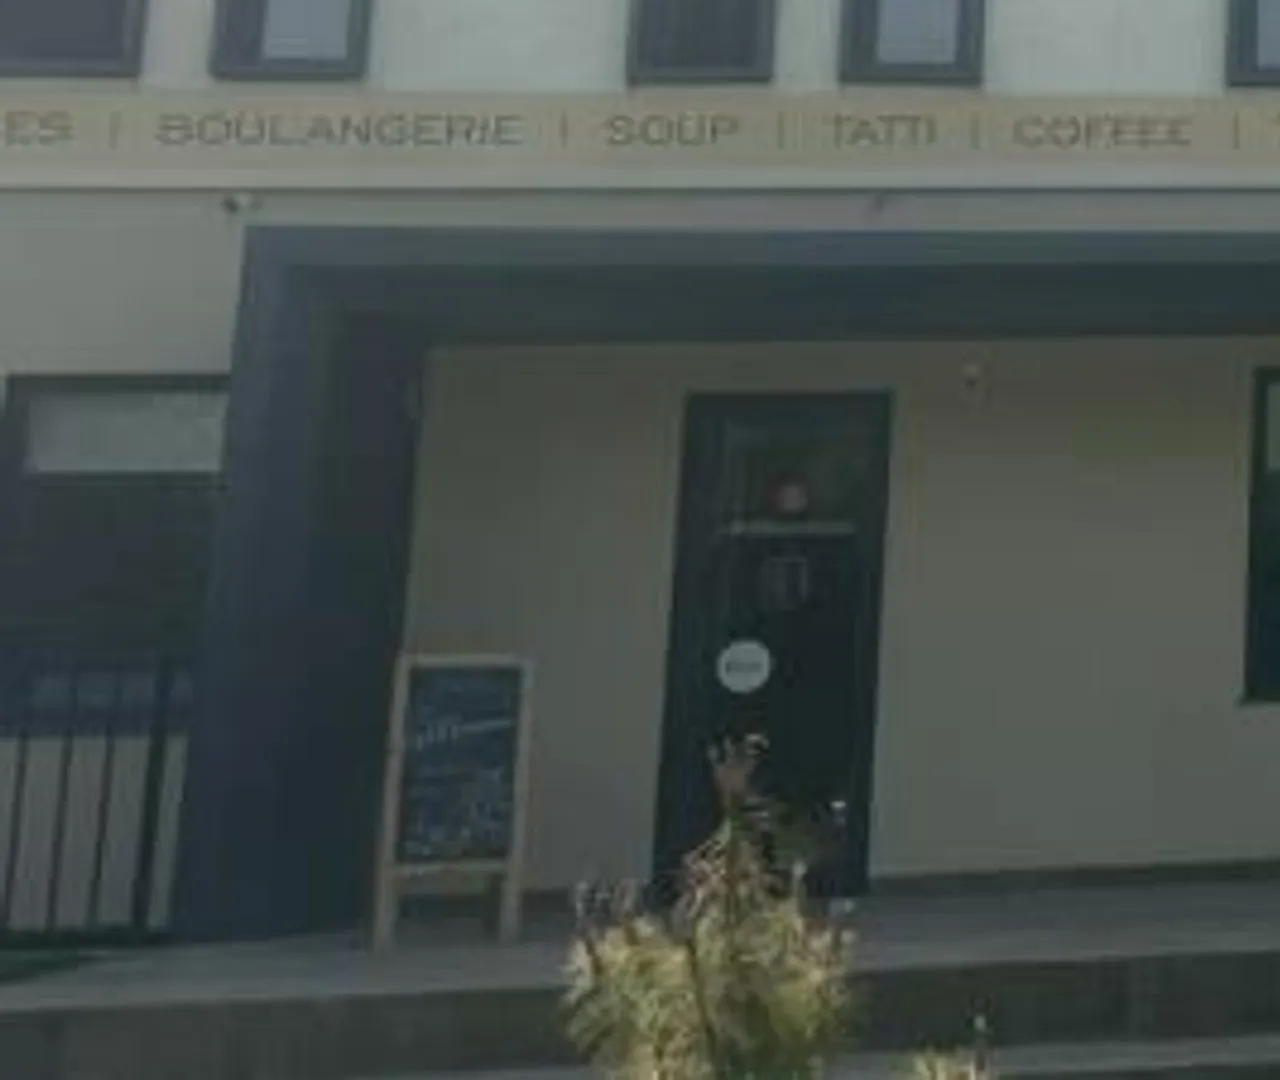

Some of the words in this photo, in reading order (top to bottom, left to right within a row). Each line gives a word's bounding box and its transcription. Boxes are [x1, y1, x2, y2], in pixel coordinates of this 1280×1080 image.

[154, 111, 524, 148] BOULANGERIE
[607, 113, 740, 148] SOUP
[831, 113, 936, 149] TATTI
[1012, 113, 1193, 149] COFFEE
